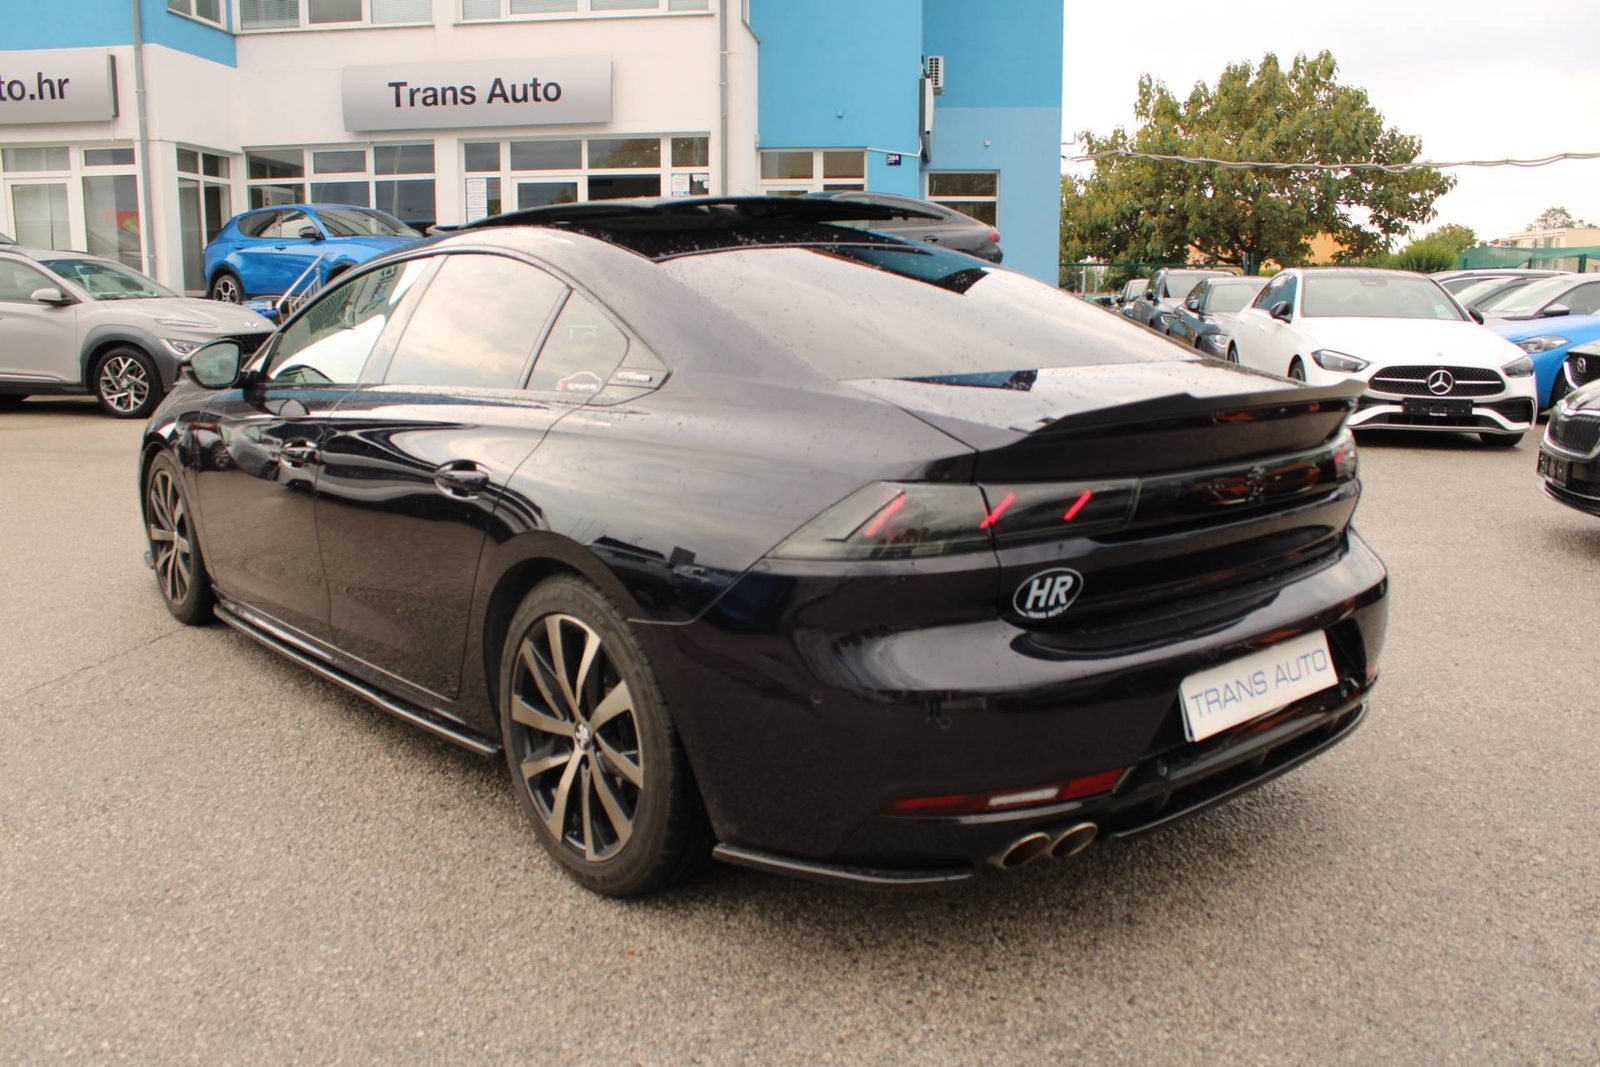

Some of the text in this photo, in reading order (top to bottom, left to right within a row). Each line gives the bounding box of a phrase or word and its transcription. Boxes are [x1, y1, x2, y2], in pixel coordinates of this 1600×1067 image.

[387, 77, 562, 108] Trans Auto
[1025, 575, 1074, 609] HR
[1190, 649, 1328, 718] TRANS AUTO
